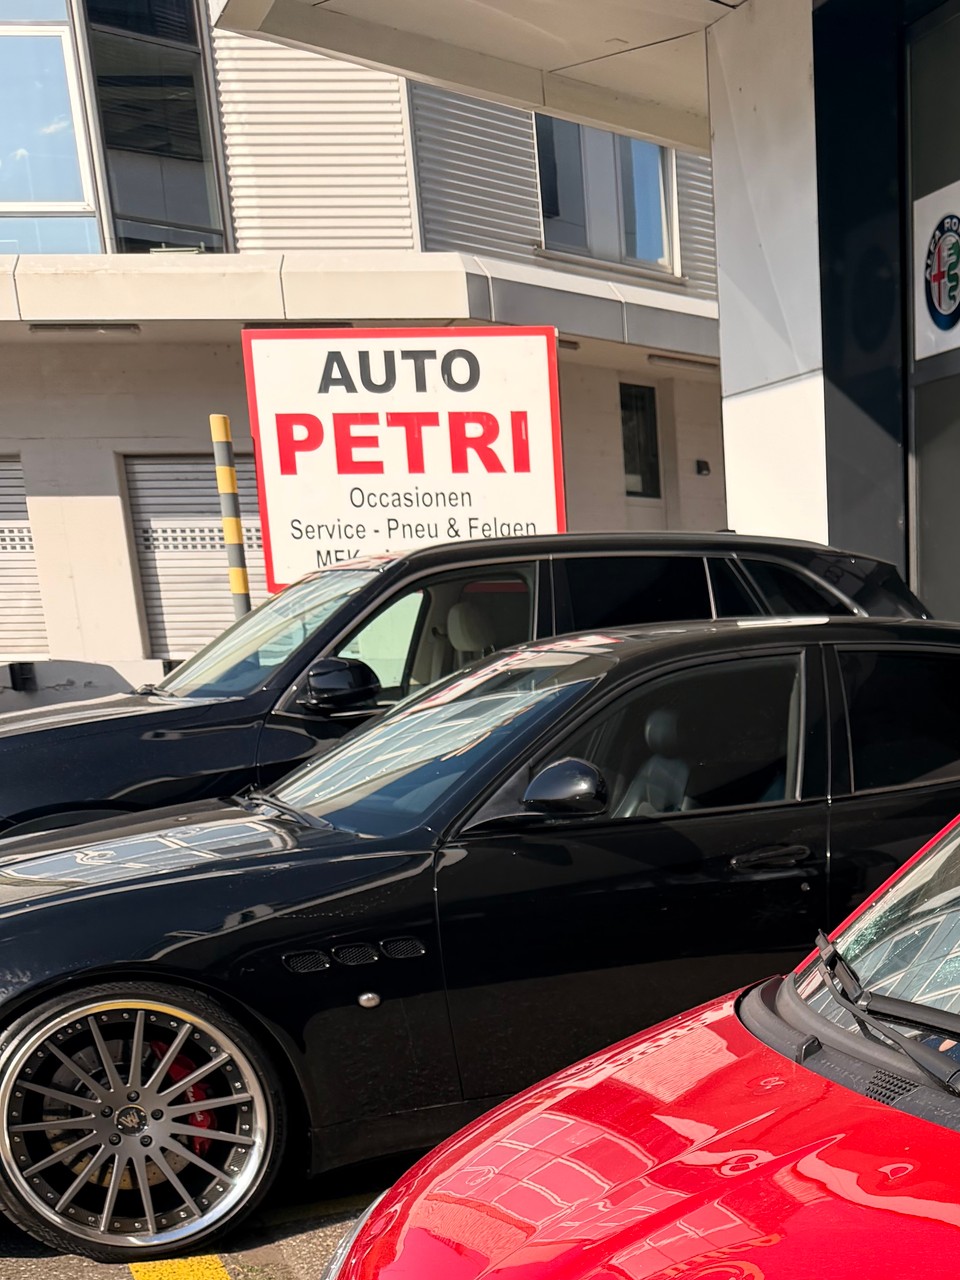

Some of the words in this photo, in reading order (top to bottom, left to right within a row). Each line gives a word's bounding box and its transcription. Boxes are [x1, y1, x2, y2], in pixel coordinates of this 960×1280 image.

[317, 348, 481, 394] AUTO
[275, 410, 531, 475] PETRI
[350, 486, 472, 508] Occasionen
[290, 518, 366, 540] Service
[387, 517, 438, 538] Pneu
[446, 517, 461, 538] &
[468, 516, 537, 538] Felgen
